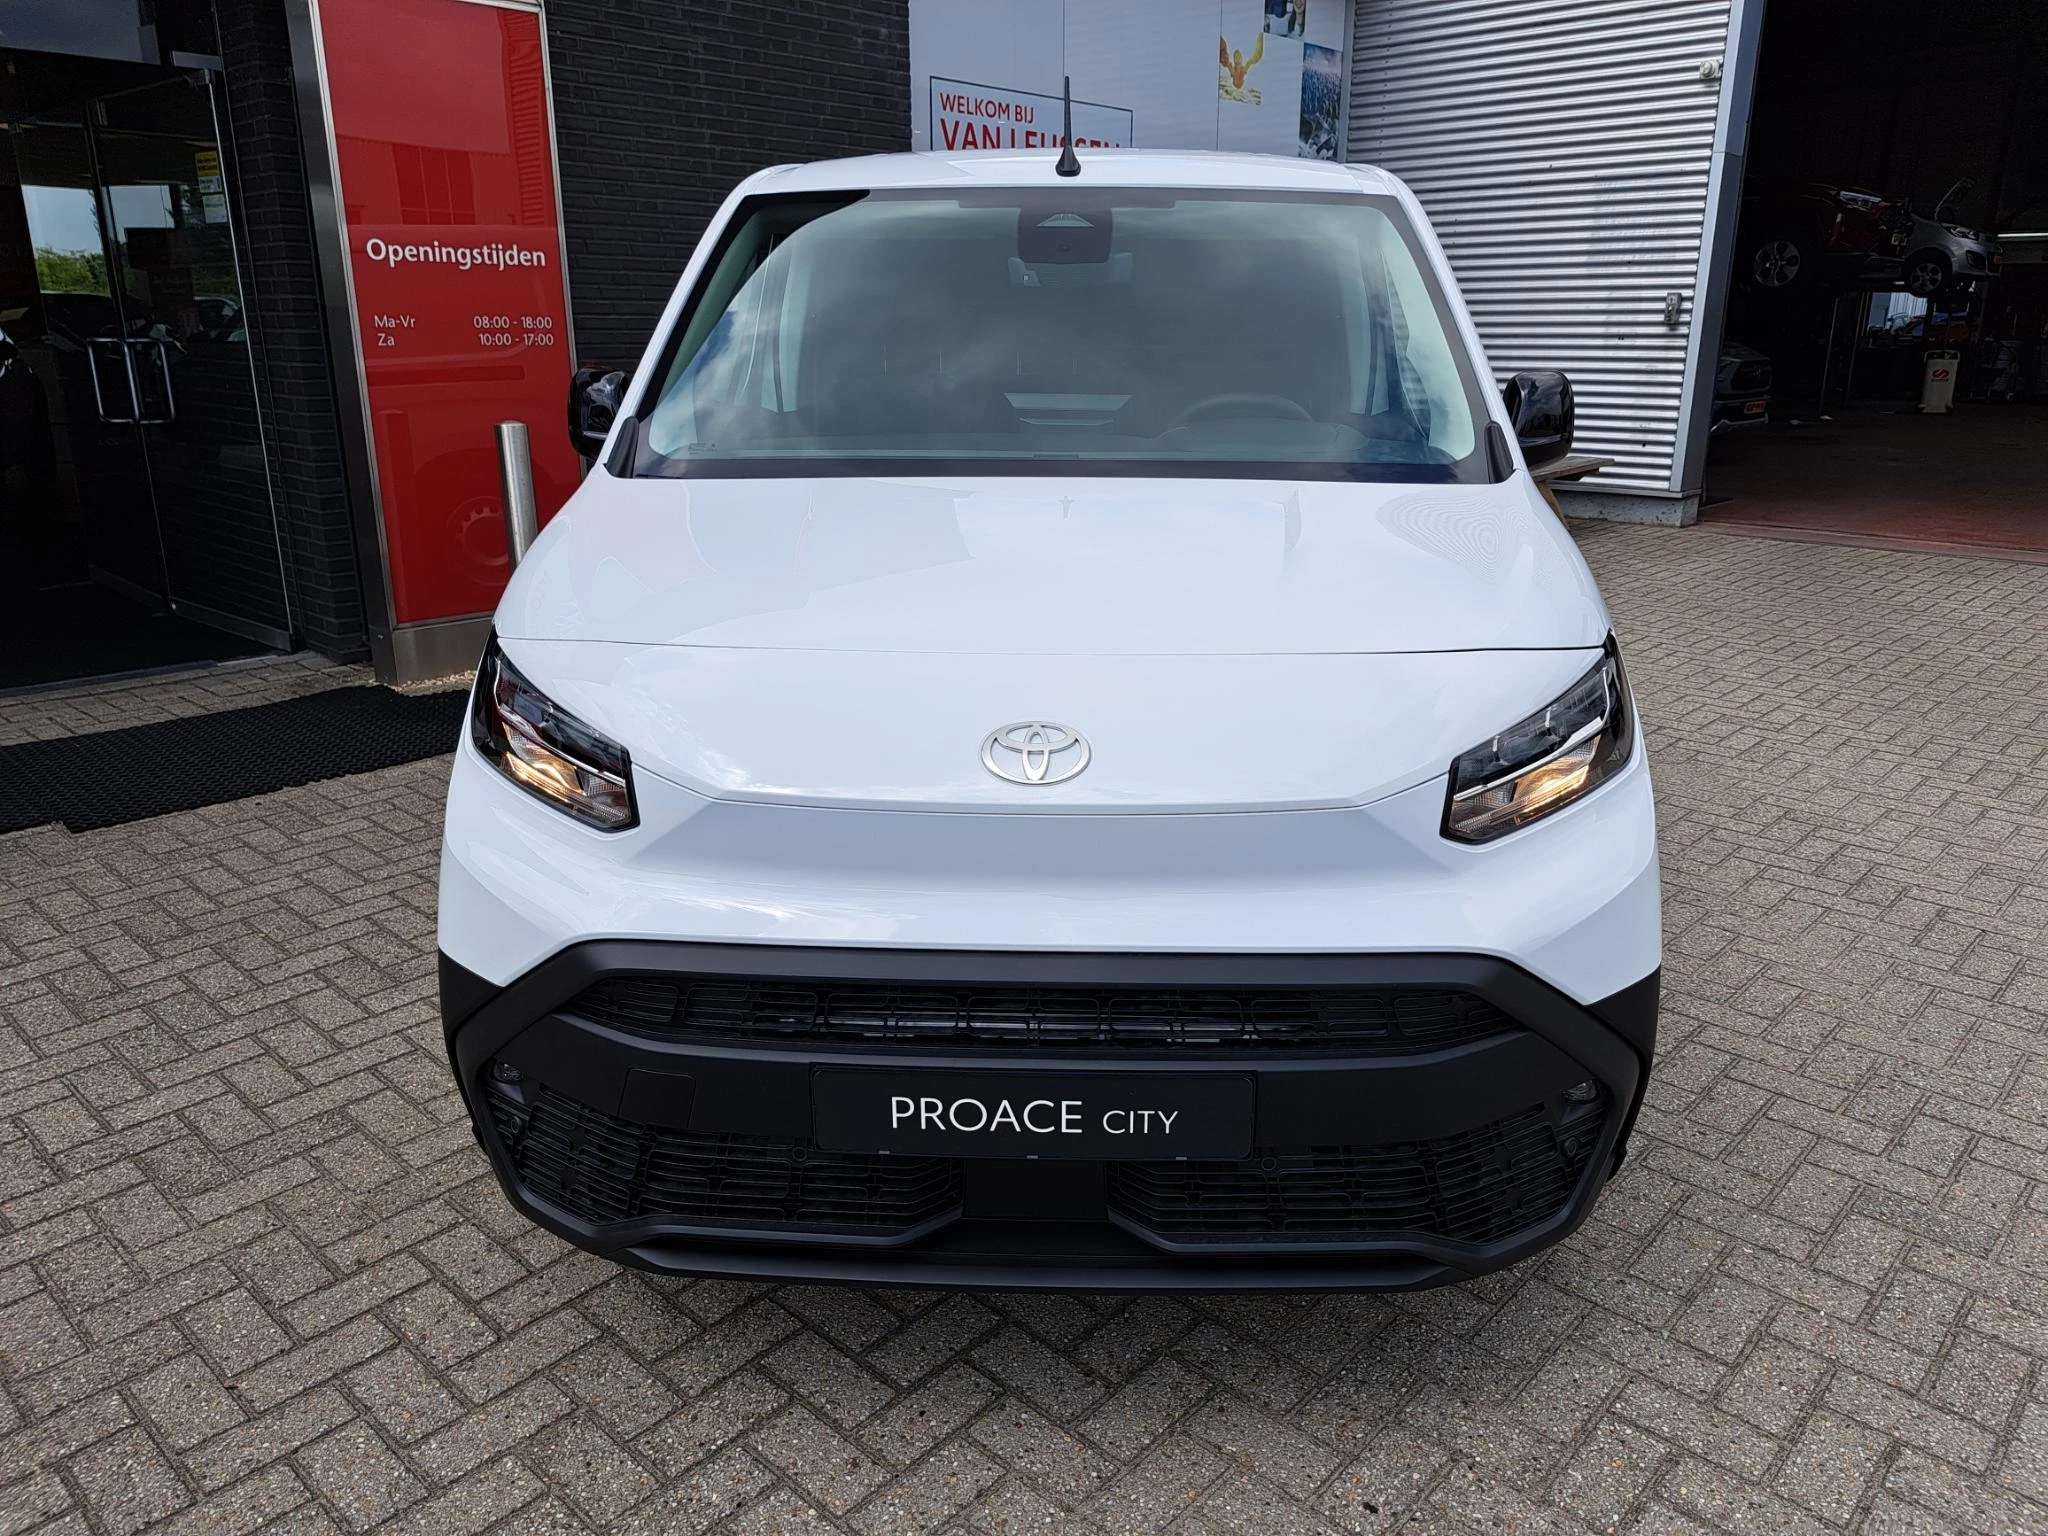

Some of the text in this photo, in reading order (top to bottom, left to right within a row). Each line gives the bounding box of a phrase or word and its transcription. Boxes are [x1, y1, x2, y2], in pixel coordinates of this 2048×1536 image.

[940, 92, 1034, 123] WELKOM BIJ
[940, 118, 1001, 150] VAN
[366, 238, 546, 271] Openingstijden
[374, 315, 416, 329] Ma-Vr
[473, 315, 510, 329] 08:00
[520, 316, 552, 329] 18:00
[377, 333, 395, 346] Za
[479, 333, 512, 346] 10:00
[523, 333, 554, 346] 17:00
[891, 1096, 1179, 1134] PROACE CITY
